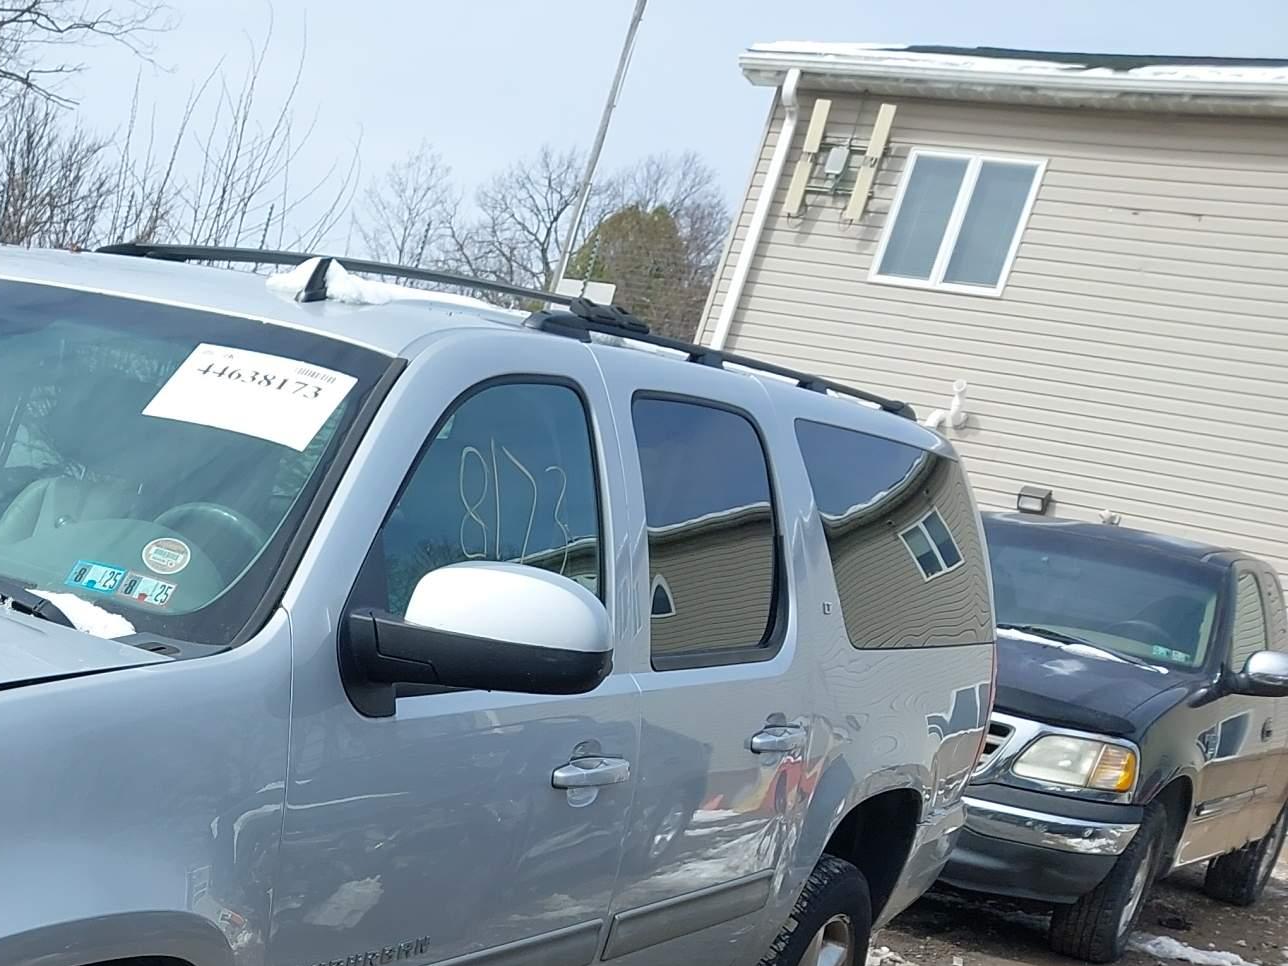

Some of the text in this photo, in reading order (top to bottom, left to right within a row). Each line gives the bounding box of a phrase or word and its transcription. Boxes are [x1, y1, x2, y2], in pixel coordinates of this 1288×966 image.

[196, 362, 324, 400] 44638173
[458, 436, 569, 575] 8173
[102, 570, 122, 590] 25
[153, 584, 173, 605] 25
